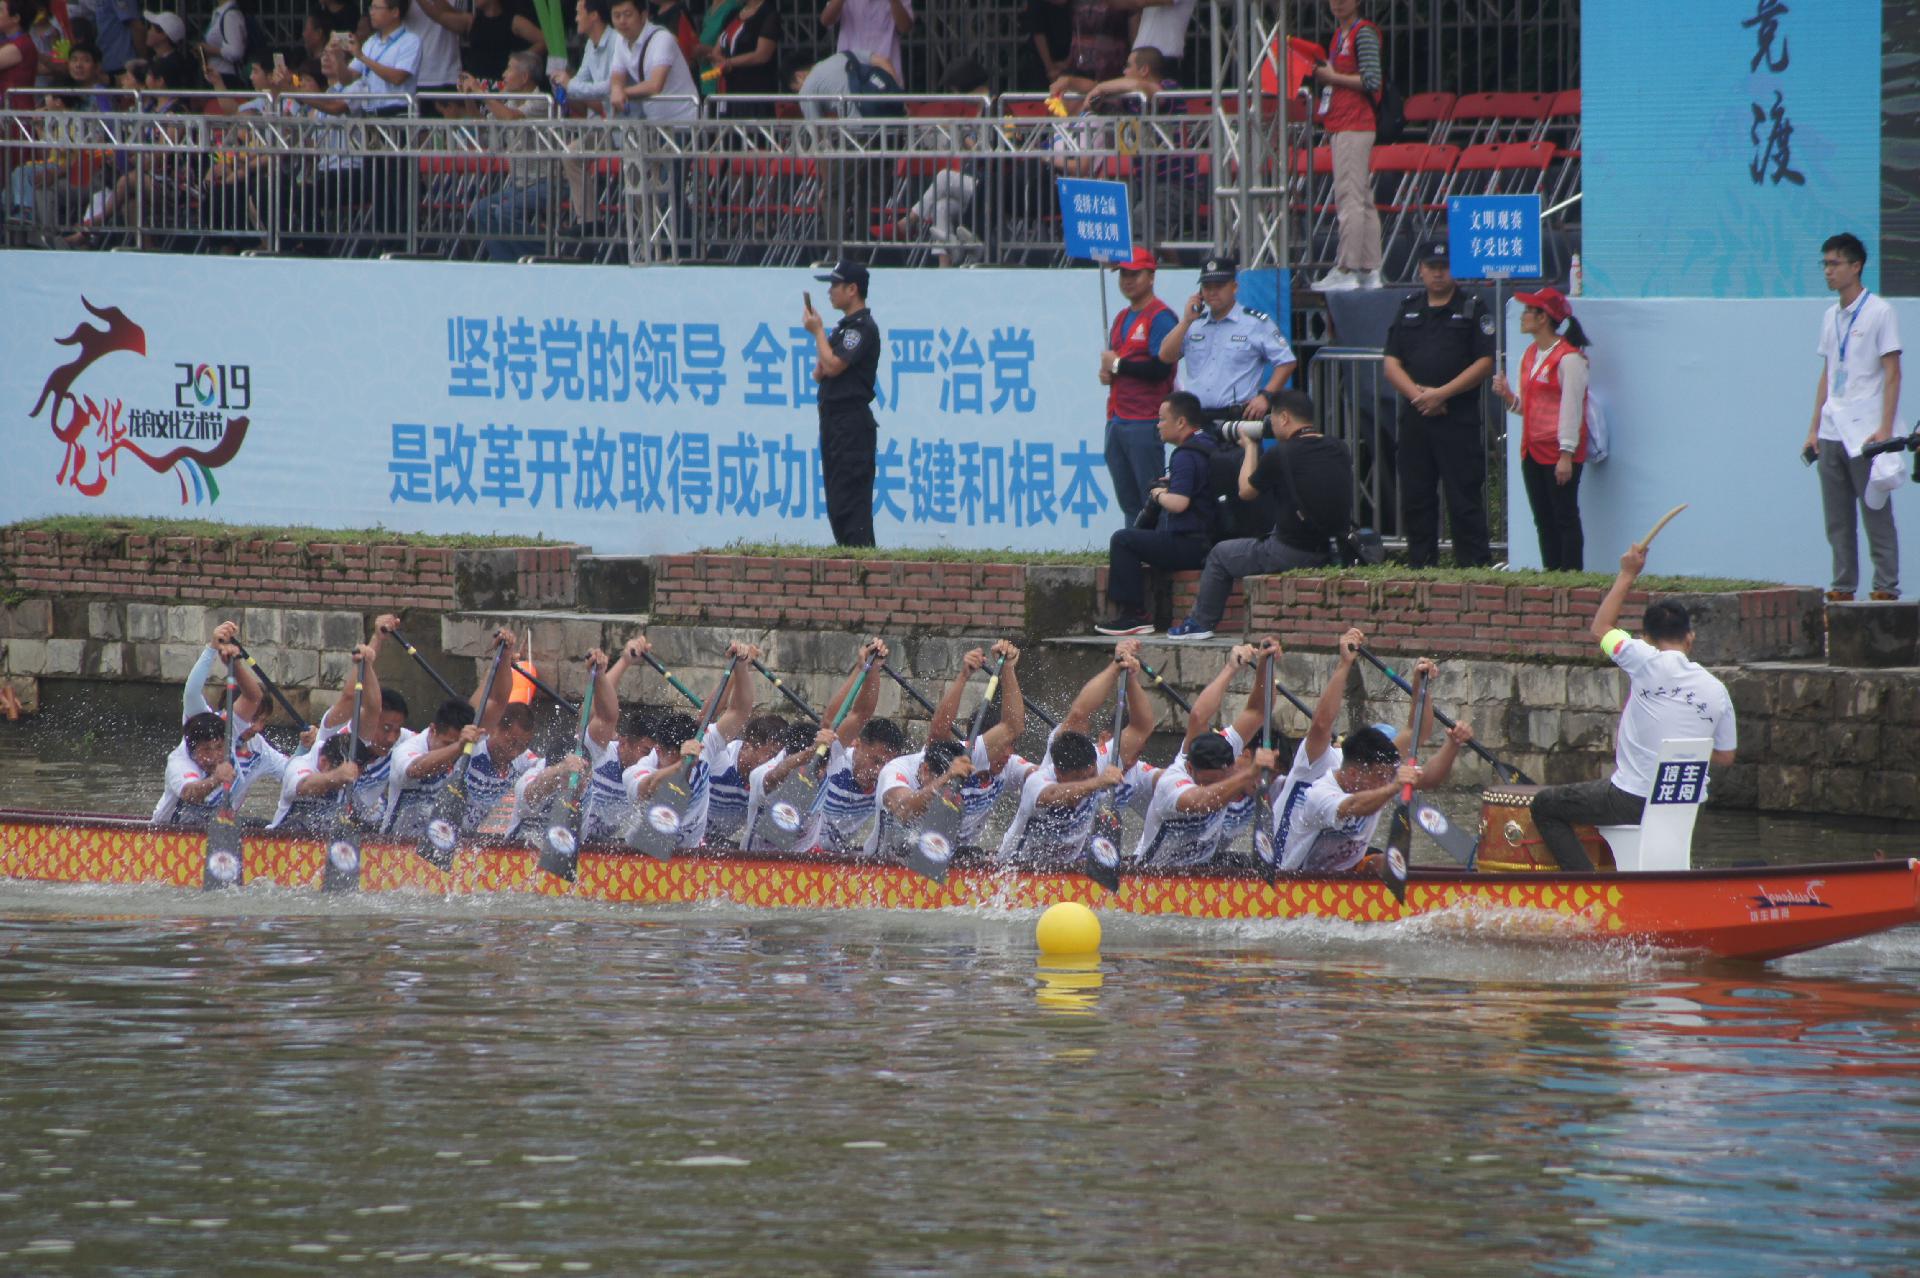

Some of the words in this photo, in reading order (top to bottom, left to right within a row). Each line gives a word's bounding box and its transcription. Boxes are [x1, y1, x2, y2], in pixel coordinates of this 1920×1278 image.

[1469, 209, 1524, 231] 文明观赛
[1470, 236, 1524, 258] 享受比赛
[447, 315, 726, 406] 坚持党的领导
[743, 322, 1036, 416] 全面严治党
[174, 362, 251, 410] 2019
[128, 407, 223, 441] 龙舟文化艺术节
[388, 423, 1109, 529] 是改革开放取得成功关键和根本
[1662, 765, 1700, 782] 培生
[1657, 784, 1696, 801] 龙舟
